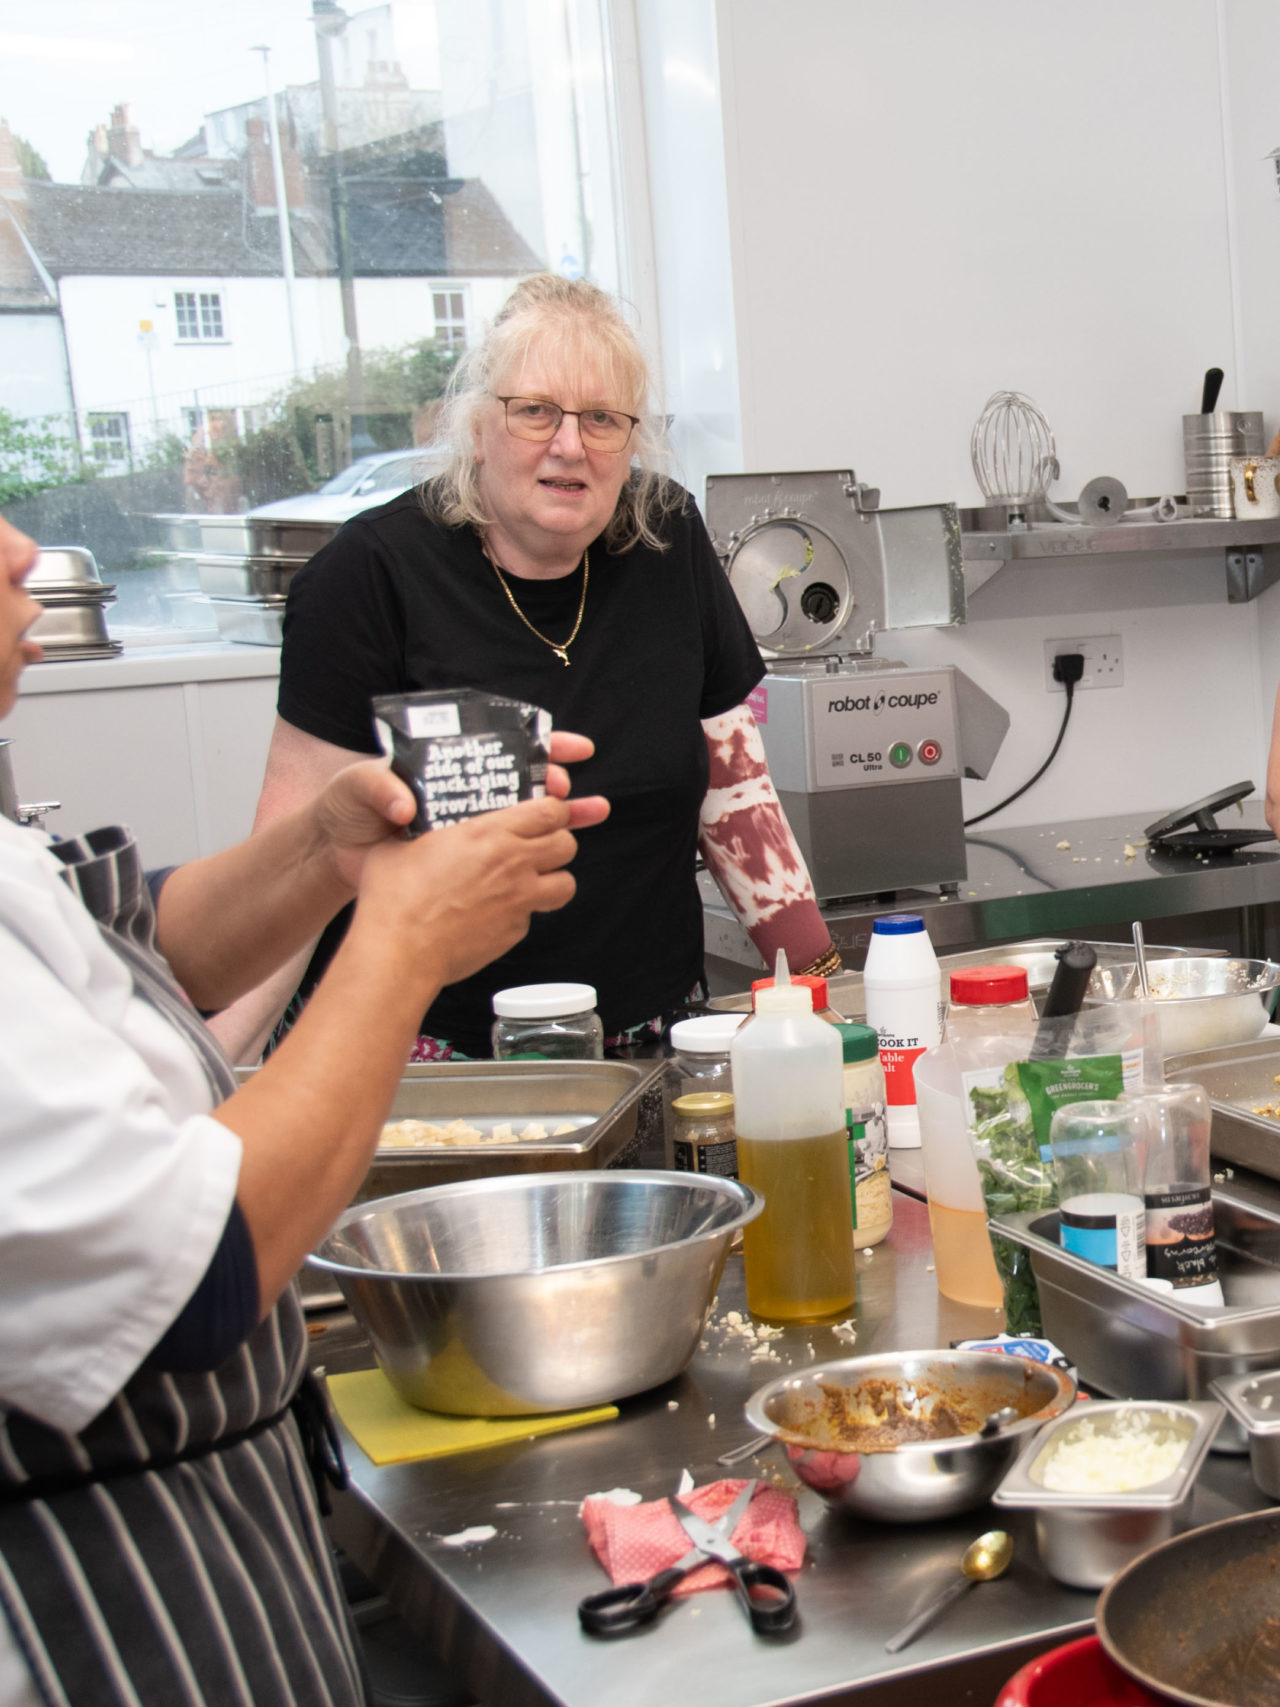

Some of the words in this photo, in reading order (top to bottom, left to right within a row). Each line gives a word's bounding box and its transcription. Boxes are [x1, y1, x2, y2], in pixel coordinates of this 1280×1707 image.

[828, 695, 871, 712] robot
[888, 692, 938, 709] coupe
[427, 738, 503, 762] Another
[849, 753, 865, 764] CL
[867, 752, 882, 763] 50
[424, 758, 462, 779] side
[464, 756, 484, 775] of
[486, 754, 516, 770] our
[863, 764, 883, 772] Ultra
[424, 770, 520, 800] packaging
[425, 791, 519, 821] providing
[879, 1039, 905, 1048] OOK
[907, 1038, 919, 1047] IT
[883, 1063, 897, 1073] alt
